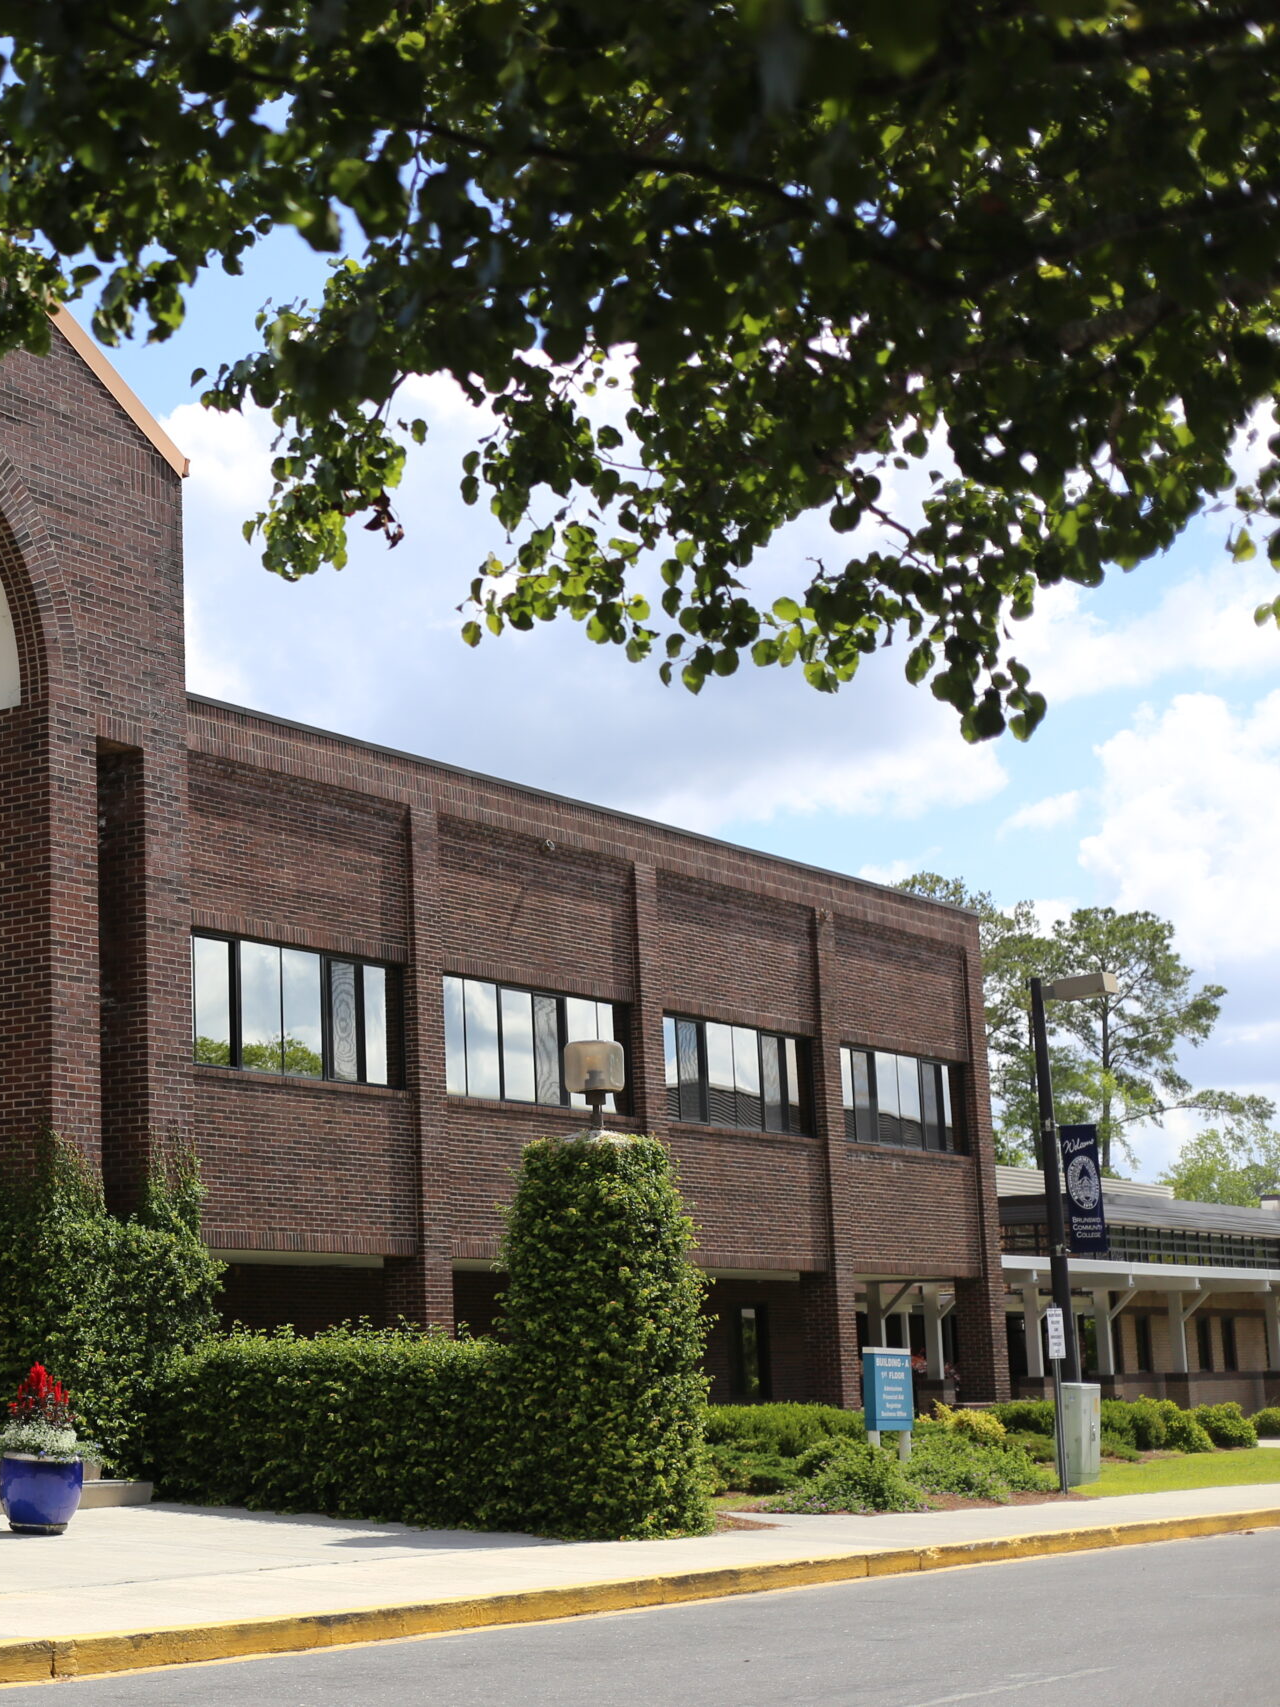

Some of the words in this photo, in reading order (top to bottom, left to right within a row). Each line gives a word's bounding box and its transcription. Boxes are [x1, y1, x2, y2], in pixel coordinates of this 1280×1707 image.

[1062, 1137, 1095, 1154] Welcome
[875, 1357, 901, 1367] BUILDING
[905, 1359, 910, 1368] A
[889, 1371, 905, 1380] FLOOR
